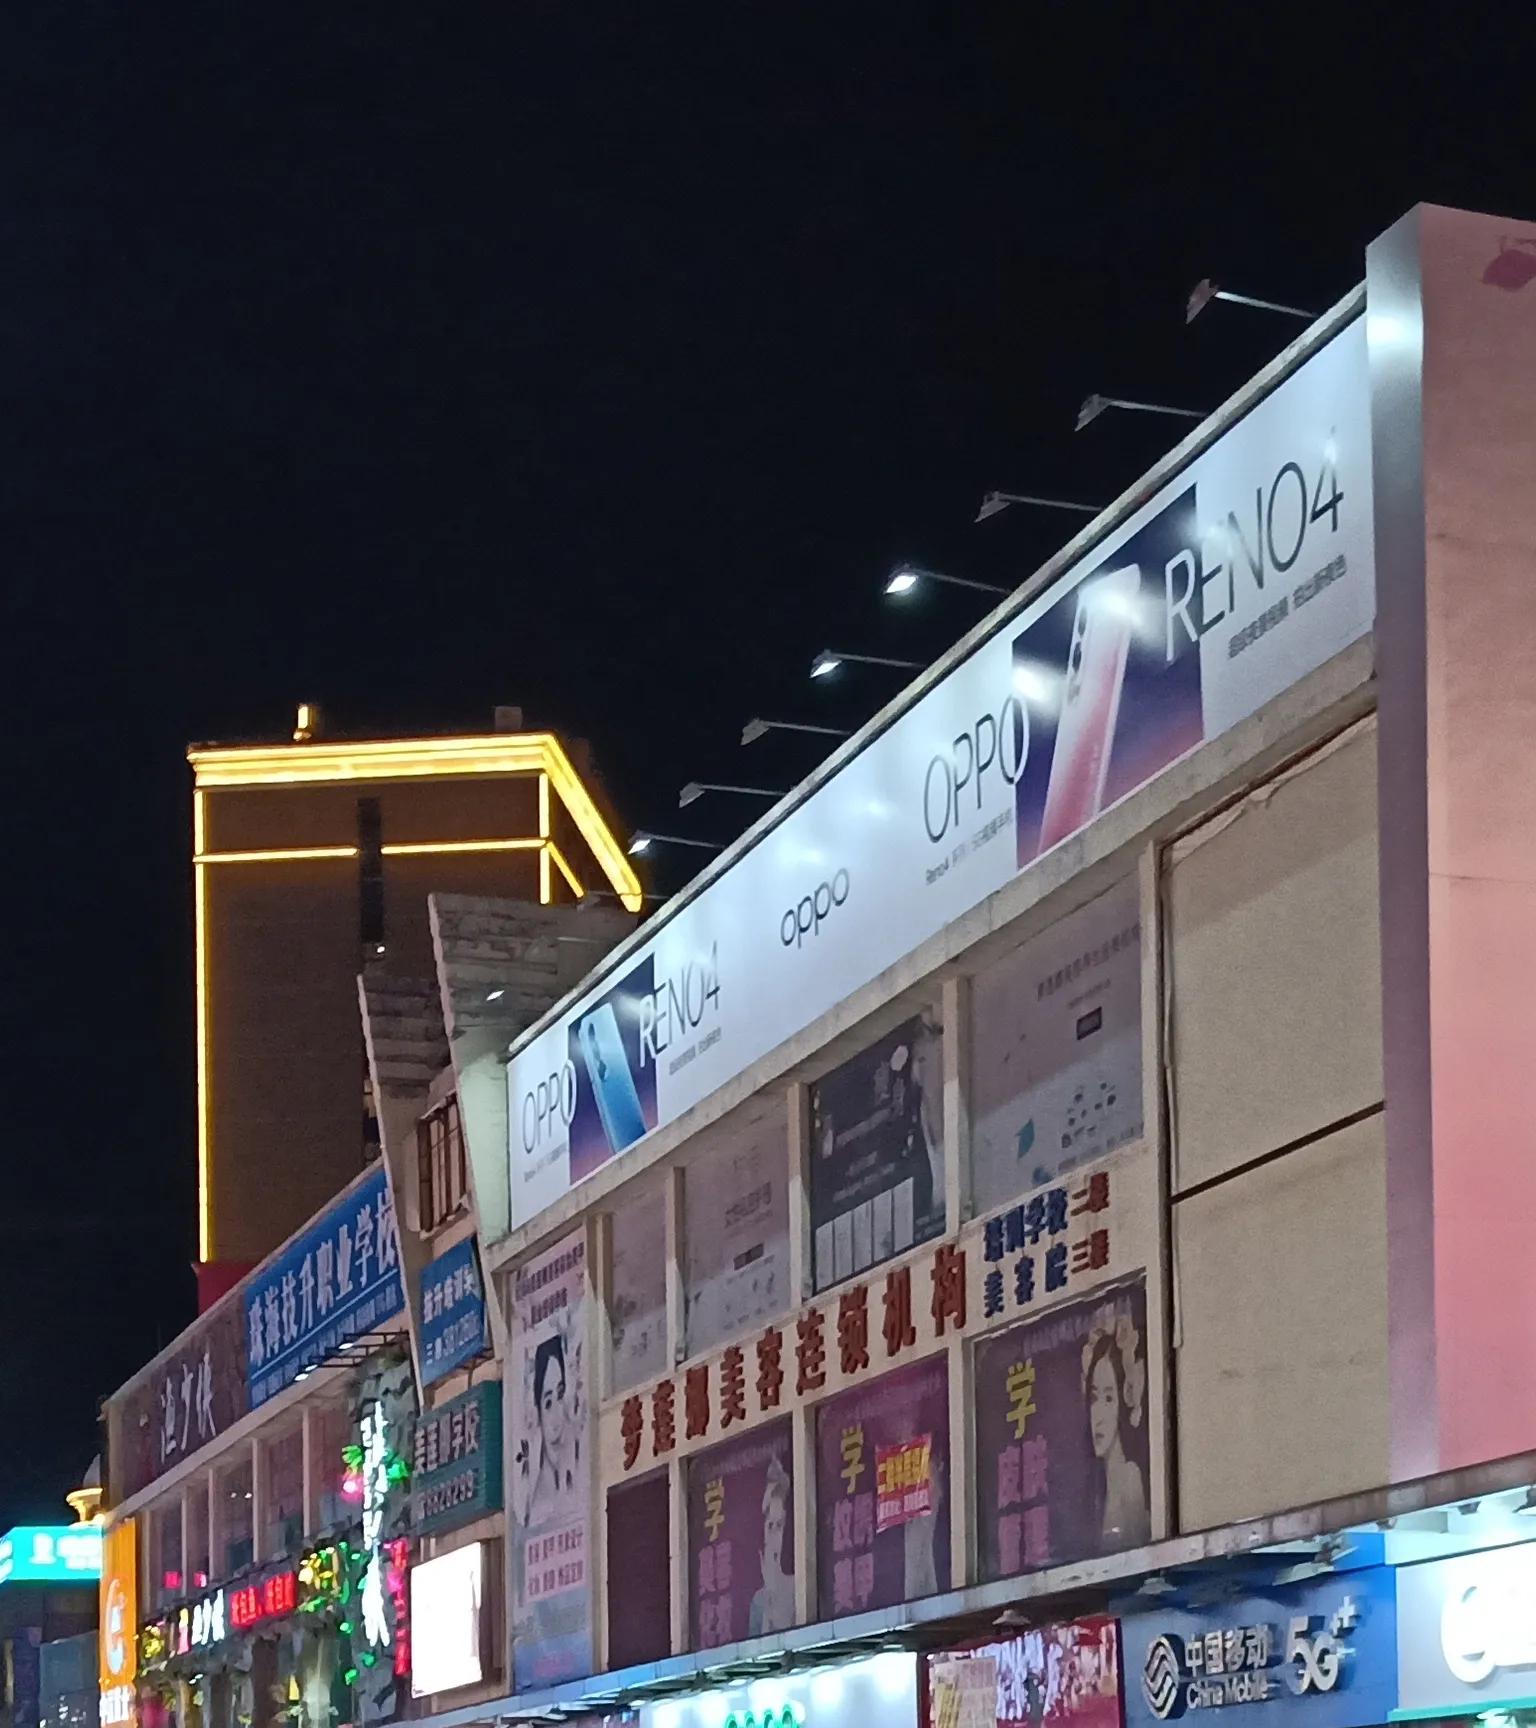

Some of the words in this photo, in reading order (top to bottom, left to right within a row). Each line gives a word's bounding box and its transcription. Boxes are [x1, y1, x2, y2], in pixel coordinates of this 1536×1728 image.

[923, 692, 1030, 843] OPPO
[780, 867, 851, 949] oppo
[522, 1058, 578, 1154] OPPO
[1005, 1358, 1037, 1440] 学
[840, 1422, 865, 1494] 学
[704, 1476, 726, 1542] 学
[1185, 1623, 1269, 1678] 中国移动
[1186, 1677, 1224, 1710] China
[1225, 1671, 1269, 1704] Mobile
